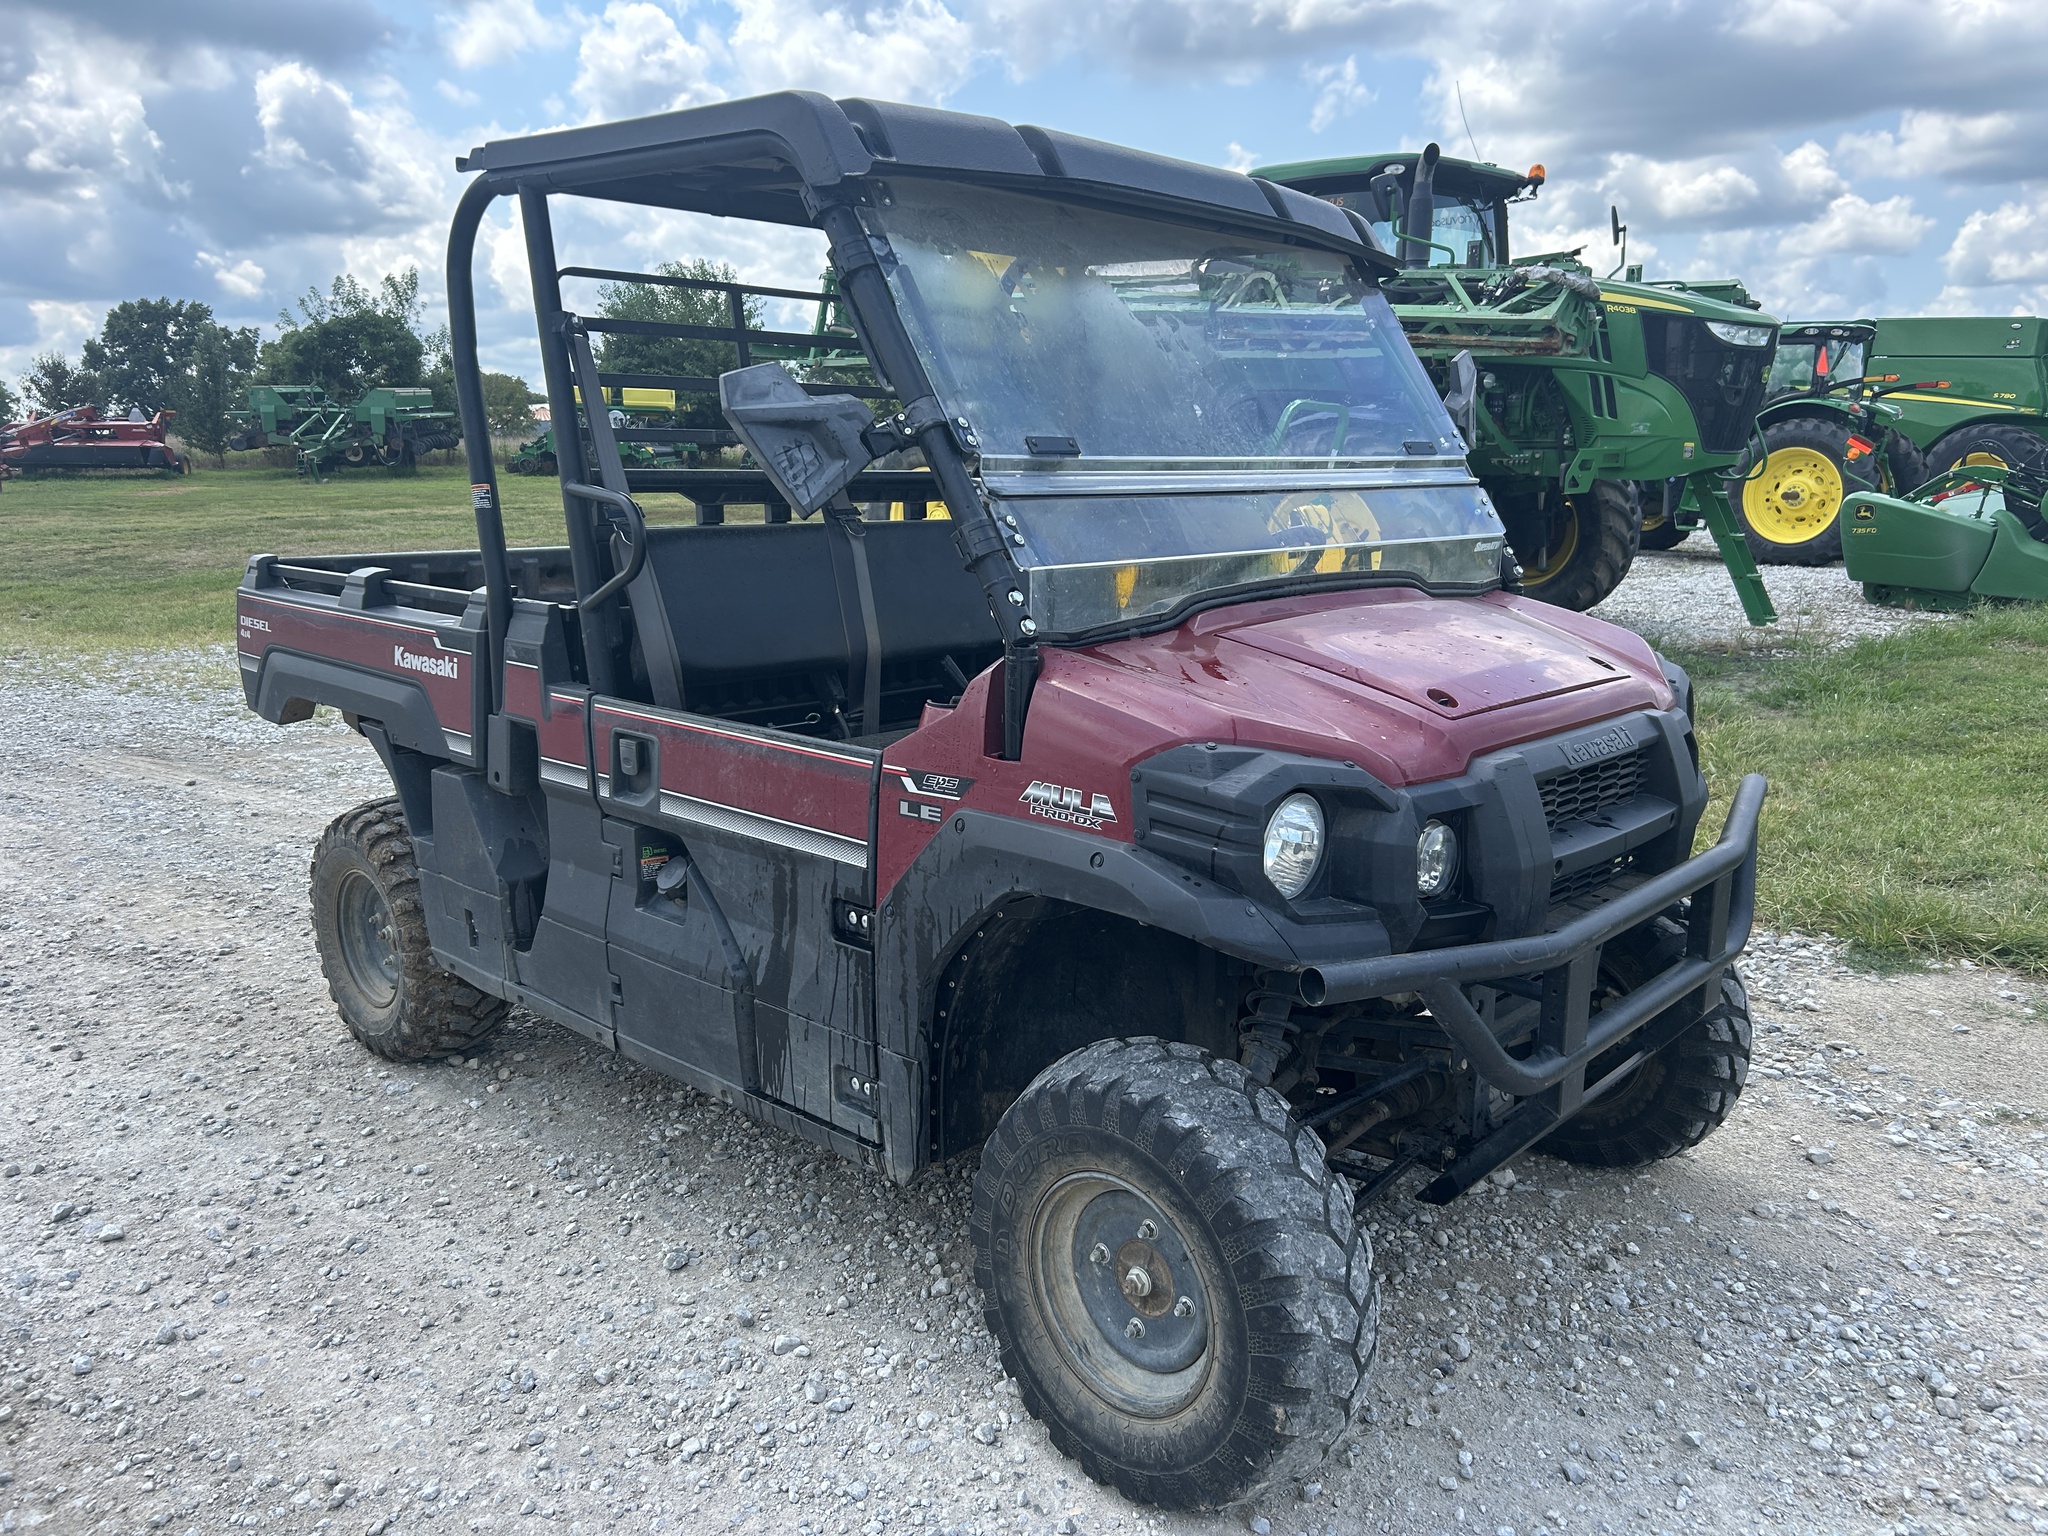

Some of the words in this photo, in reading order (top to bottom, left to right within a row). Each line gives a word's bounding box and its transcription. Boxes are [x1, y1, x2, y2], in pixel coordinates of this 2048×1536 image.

[1606, 304, 1637, 314] R4038
[240, 615, 272, 633] DIESEL
[394, 644, 458, 679] Kawasaki
[1558, 725, 1637, 765] Kawasaki
[900, 800, 941, 822] LE
[1018, 780, 1118, 823] MULE
[1030, 804, 1103, 831] PRO-DX
[1000, 1132, 1091, 1219] DURO
